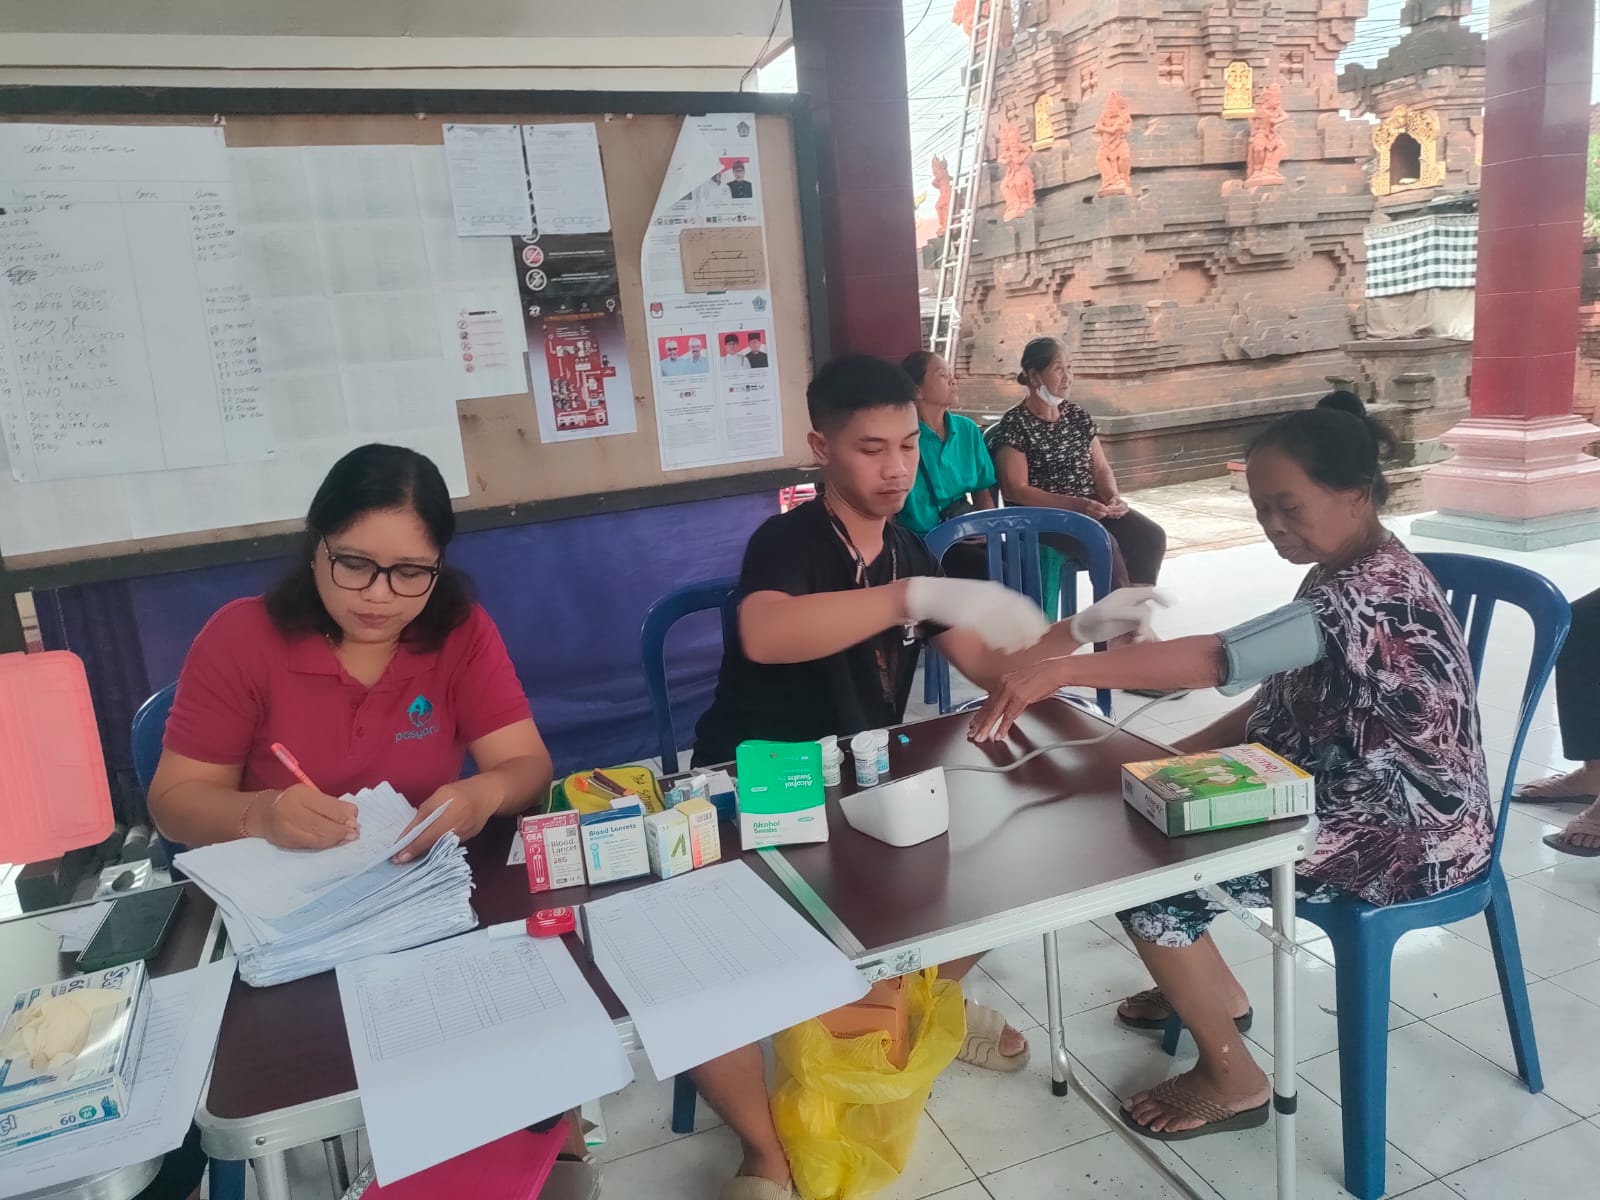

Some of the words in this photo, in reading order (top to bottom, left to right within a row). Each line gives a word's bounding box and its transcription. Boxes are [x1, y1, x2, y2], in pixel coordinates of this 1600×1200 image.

[785, 780, 813, 789] Alcohol
[753, 820, 780, 828] Alcohol
[589, 827, 609, 837] Blood
[610, 823, 637, 833] Lancets
[526, 833, 543, 841] GEA
[551, 838, 574, 848] Blood
[552, 844, 577, 854] Lancet
[553, 856, 568, 865] 28G
[60, 1115, 76, 1126] 60
